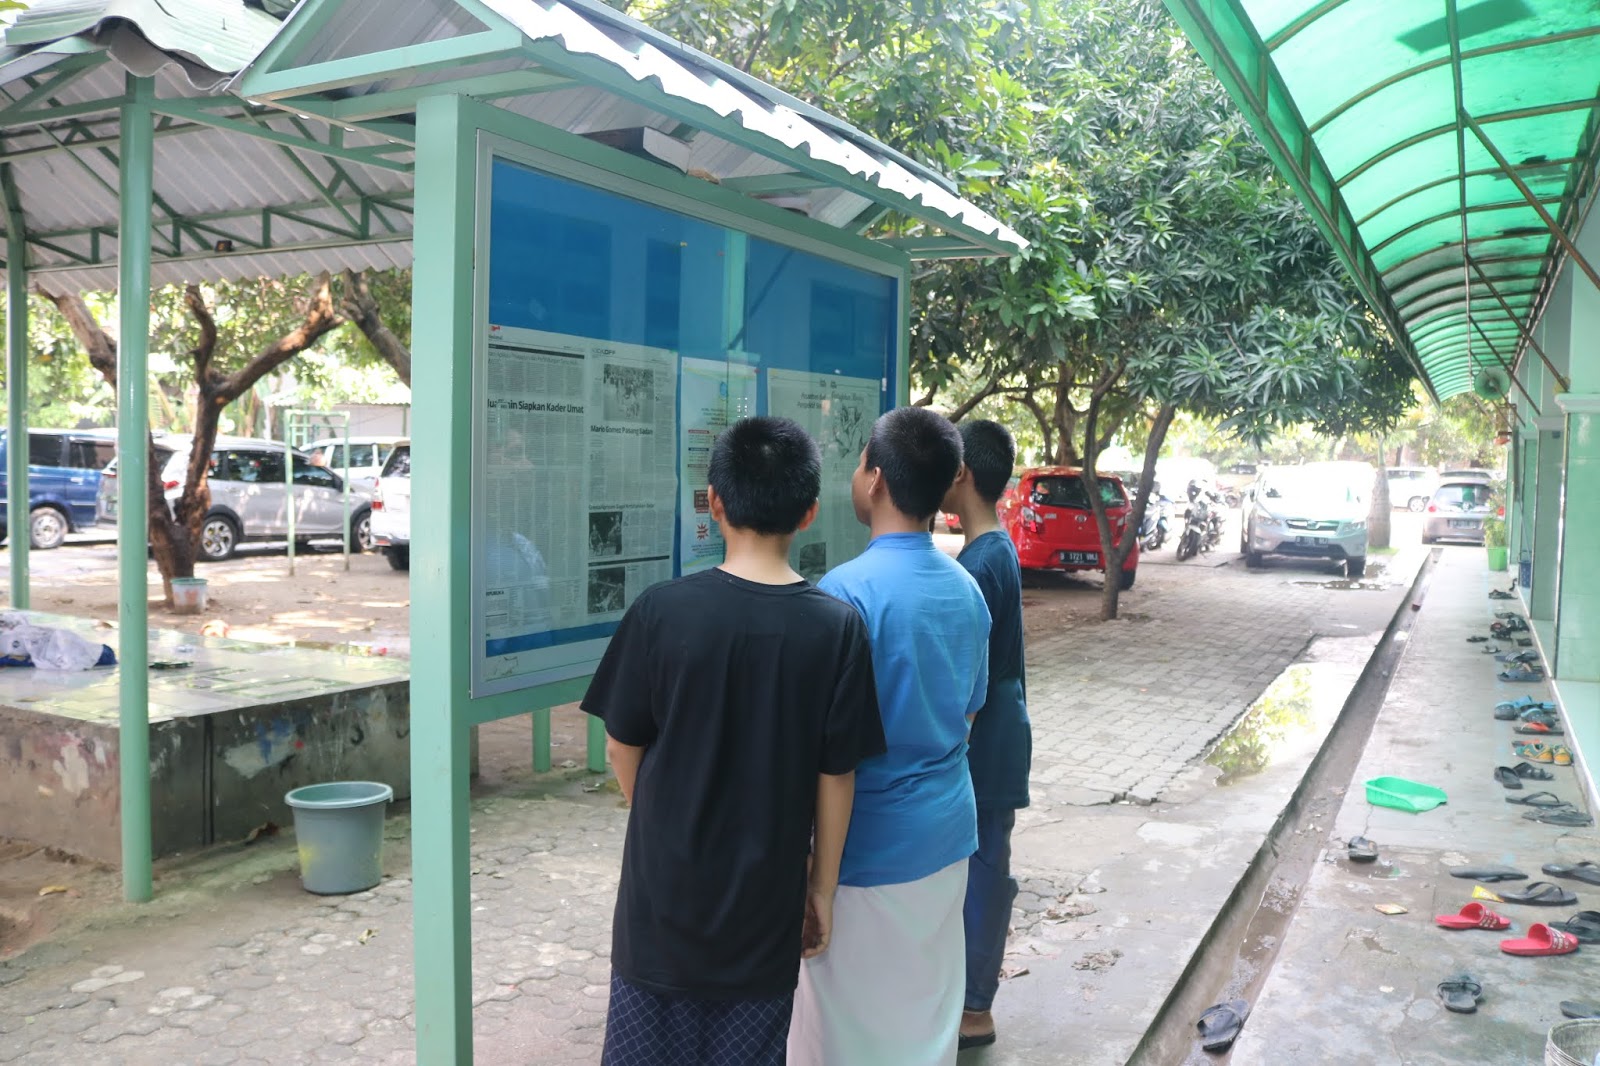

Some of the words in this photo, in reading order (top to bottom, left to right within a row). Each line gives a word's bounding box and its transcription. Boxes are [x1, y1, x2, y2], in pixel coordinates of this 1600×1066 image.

[518, 400, 545, 413] Siapkan
[546, 402, 566, 412] Kader
[566, 404, 584, 414] Umat
[590, 425, 605, 433] Mario
[605, 426, 621, 434] Gomez
